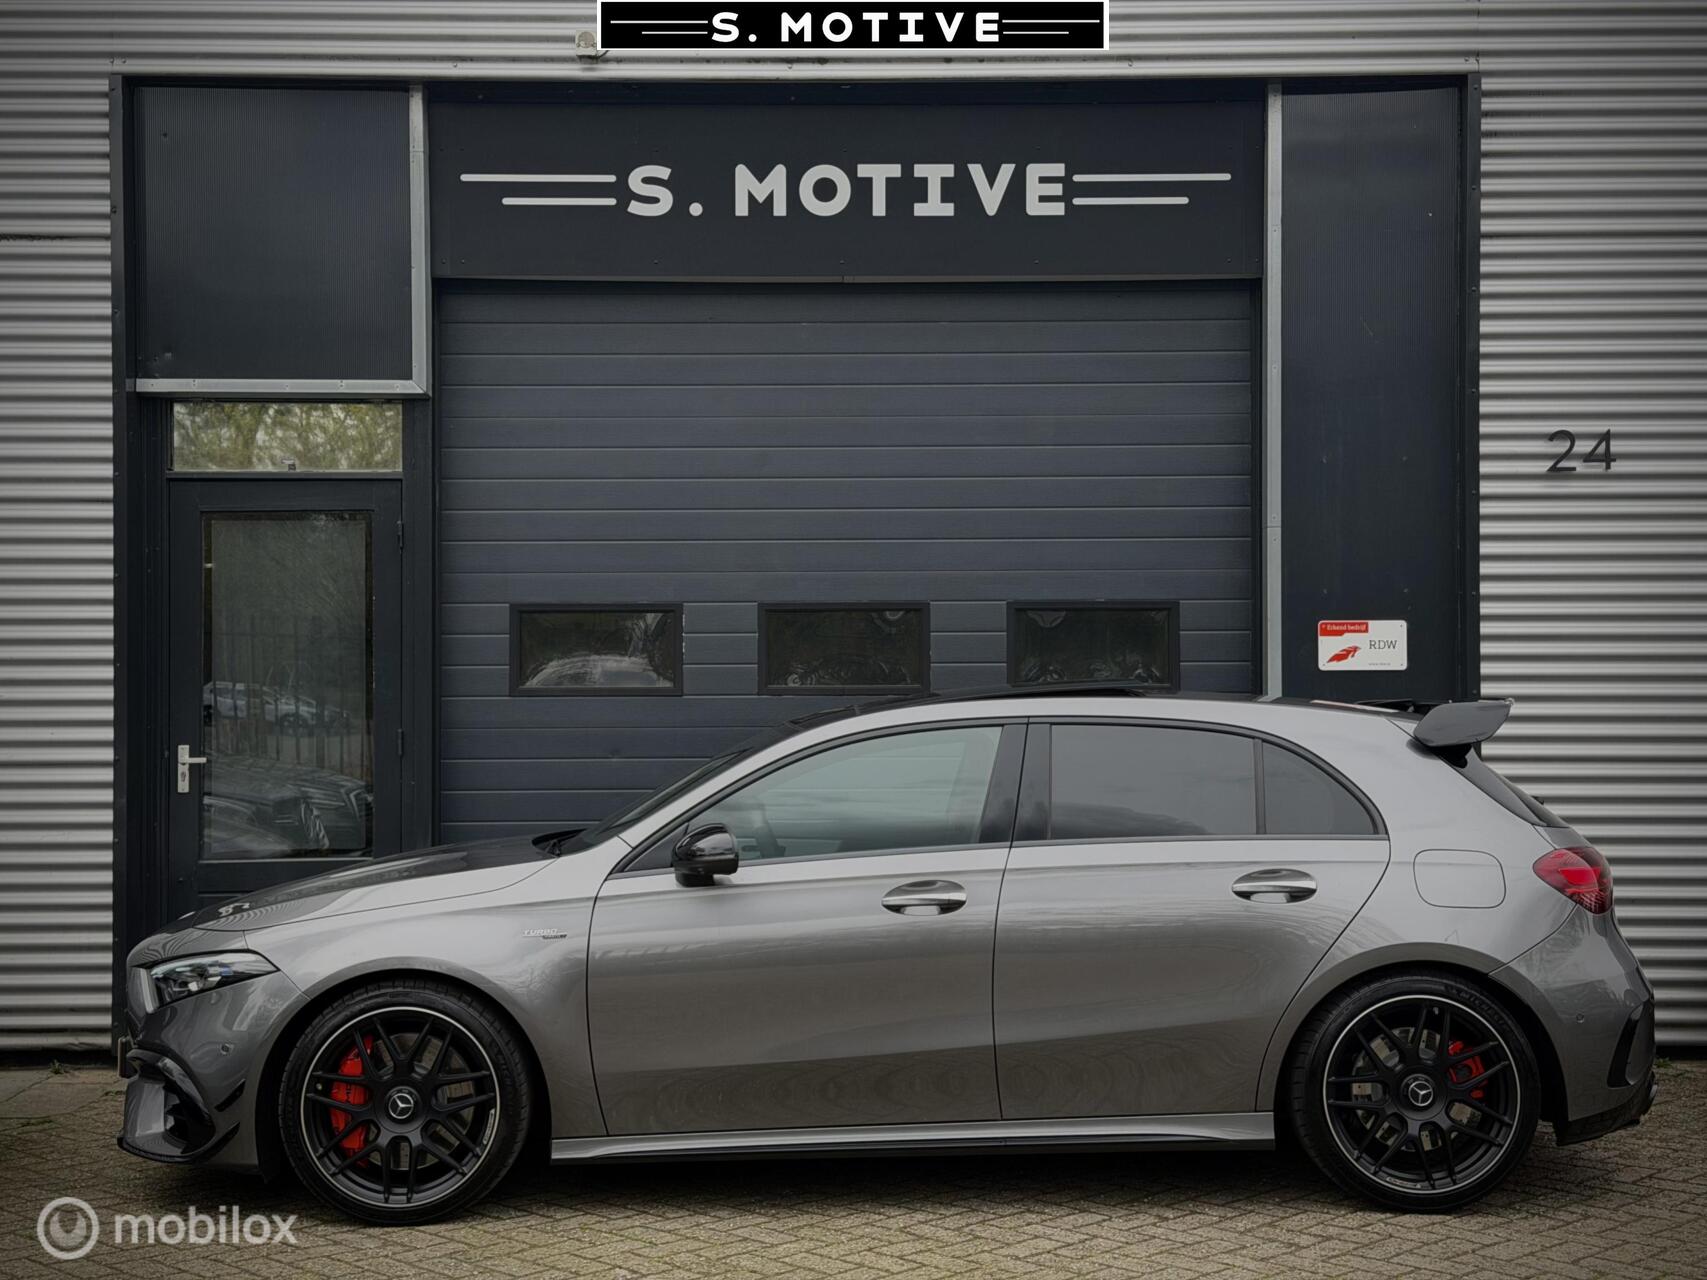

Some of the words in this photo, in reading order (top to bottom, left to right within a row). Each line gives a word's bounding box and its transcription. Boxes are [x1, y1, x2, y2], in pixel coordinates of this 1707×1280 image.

[627, 164, 703, 217] S.
[734, 162, 1066, 218] MOTIVE
[1547, 428, 1616, 472] 24
[1369, 639, 1398, 650] RDW
